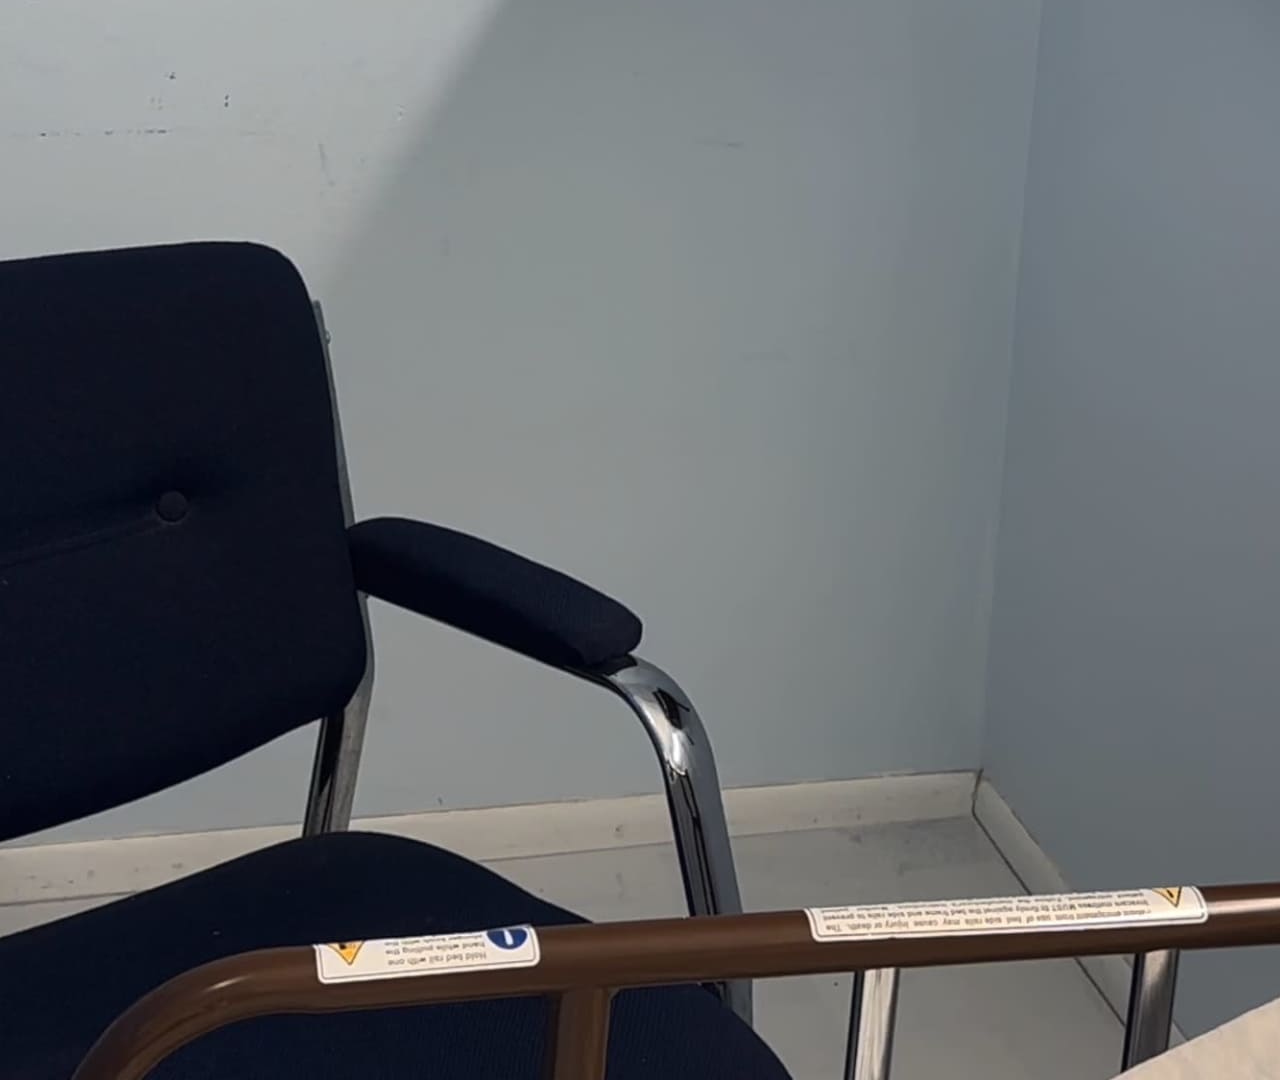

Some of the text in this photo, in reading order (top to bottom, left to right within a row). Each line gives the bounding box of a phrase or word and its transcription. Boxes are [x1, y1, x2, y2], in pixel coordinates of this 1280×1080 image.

[943, 918, 961, 926] may
[826, 924, 843, 932] The
[436, 944, 460, 952] while
[446, 954, 464, 962] bed
[466, 952, 487, 961] Hold
[408, 957, 427, 966] with
